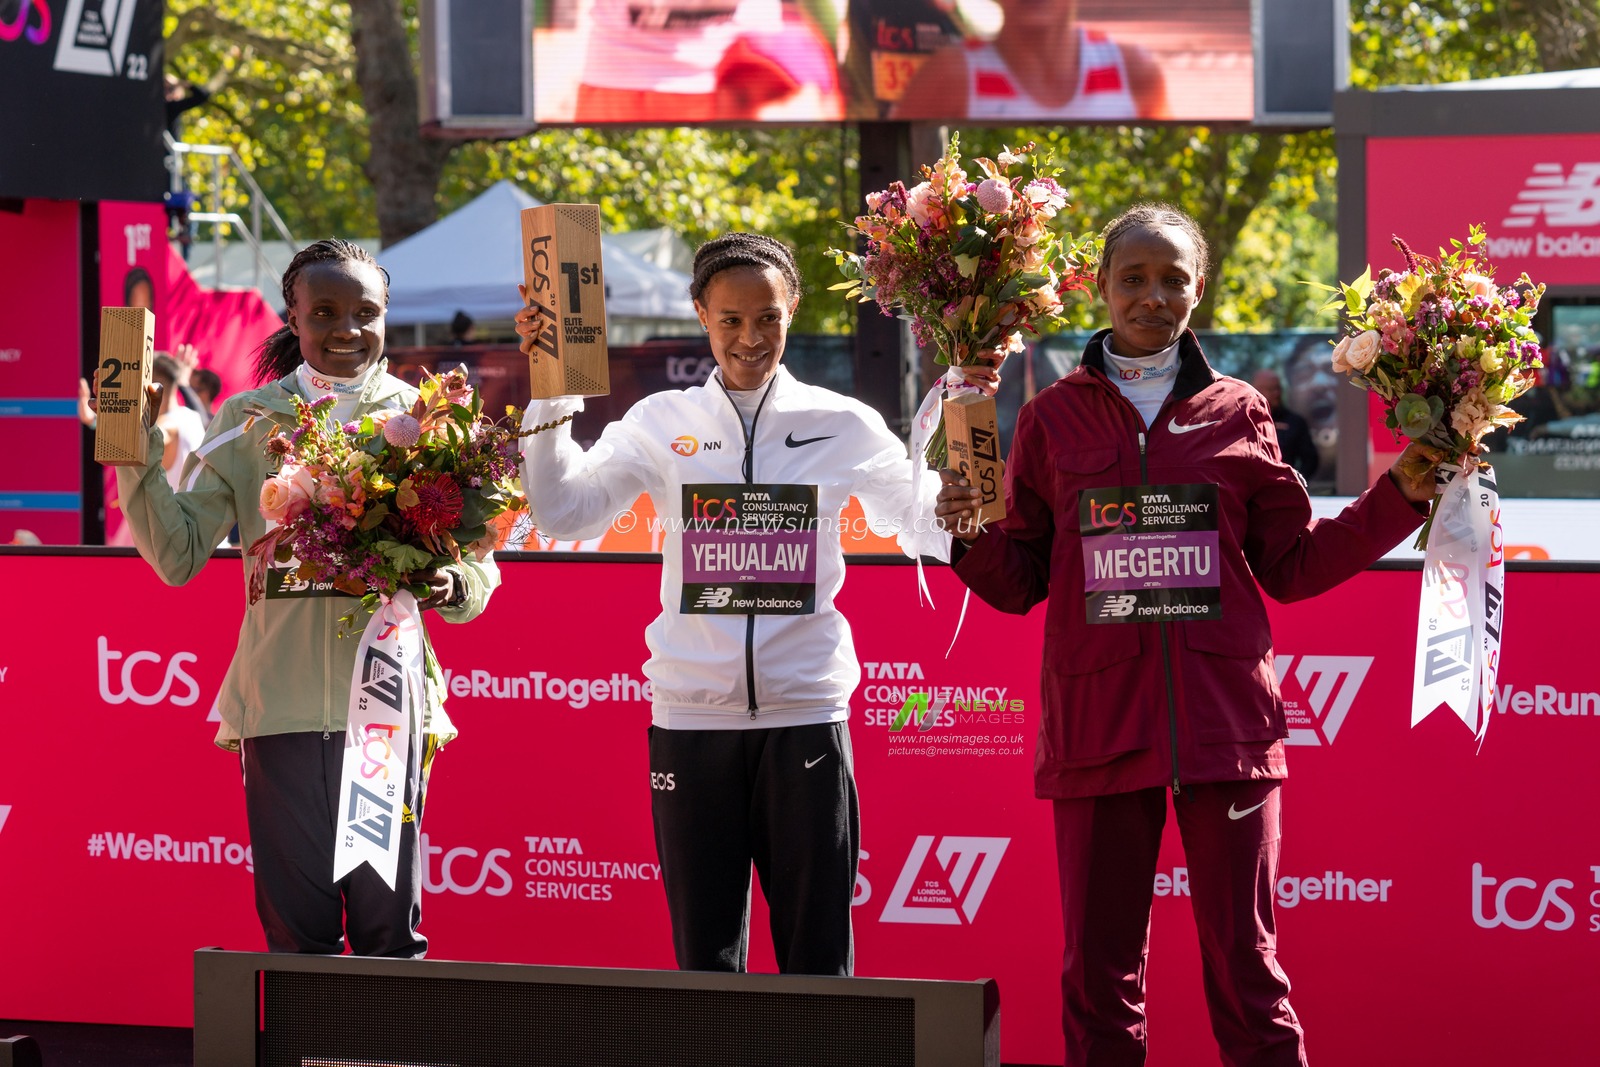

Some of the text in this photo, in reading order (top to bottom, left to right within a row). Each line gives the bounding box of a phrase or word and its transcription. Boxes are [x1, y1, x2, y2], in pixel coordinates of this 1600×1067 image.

[127, 53, 148, 81] 22
[1536, 232, 1600, 258] bala
[531, 235, 552, 293] tcs
[561, 262, 600, 314] 1st
[550, 293, 556, 306] 20
[564, 317, 583, 326] ELITE
[564, 326, 603, 335] WOMEN'S
[565, 335, 596, 344] WINNER
[532, 351, 538, 364] 22
[100, 358, 140, 389] 2nd
[1119, 368, 1141, 380] tcs
[312, 376, 331, 390] tcs
[100, 399, 138, 407] WOMEN'S
[100, 406, 130, 414] WINNER
[704, 440, 722, 451] NN
[980, 466, 997, 505] tcs
[742, 493, 771, 501] TATA
[1141, 494, 1171, 503] TATA
[1480, 493, 1489, 507] 20
[693, 493, 737, 522] tcs
[742, 503, 809, 514] CONSULTANCY
[1090, 498, 1137, 528] tcs
[1141, 504, 1210, 515] CONSULTANCY
[742, 513, 785, 522] SERVICES
[1142, 515, 1186, 526] SERVICES
[691, 543, 809, 572] YEHUALAW
[1093, 546, 1211, 579] MEGERTU
[312, 582, 333, 591] new
[732, 600, 755, 608] new
[757, 598, 803, 608] balance
[1138, 606, 1162, 615] new
[1163, 603, 1209, 615] balance
[97, 635, 200, 707] tcs
[863, 662, 925, 680] TATA
[863, 685, 1008, 704] CONSULTANCY
[358, 697, 367, 711] 22
[361, 723, 401, 780] tcs
[650, 772, 676, 791] EOS
[386, 784, 396, 797] 20
[345, 835, 354, 848] 22
[524, 836, 583, 854] TATA
[421, 832, 513, 896] tcs
[525, 858, 661, 881] CONSULTANCY
[525, 881, 612, 901] SERVICES
[1471, 862, 1575, 932] tcs
